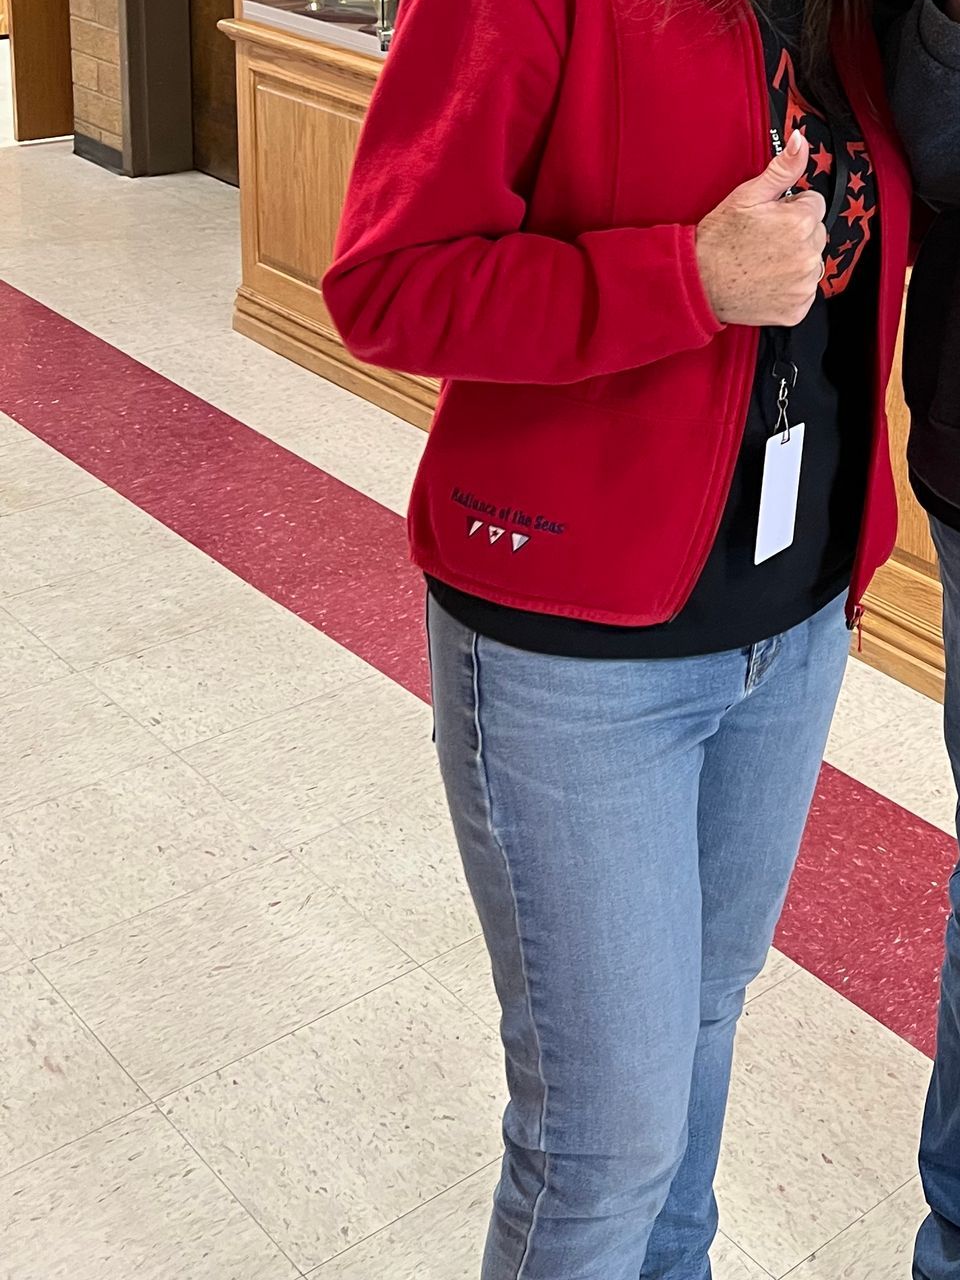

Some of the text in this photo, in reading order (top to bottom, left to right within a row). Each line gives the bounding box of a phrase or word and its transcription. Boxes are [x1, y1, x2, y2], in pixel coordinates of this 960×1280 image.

[498, 508, 511, 521] of
[512, 510, 532, 527] the
[534, 515, 565, 534] Seas
